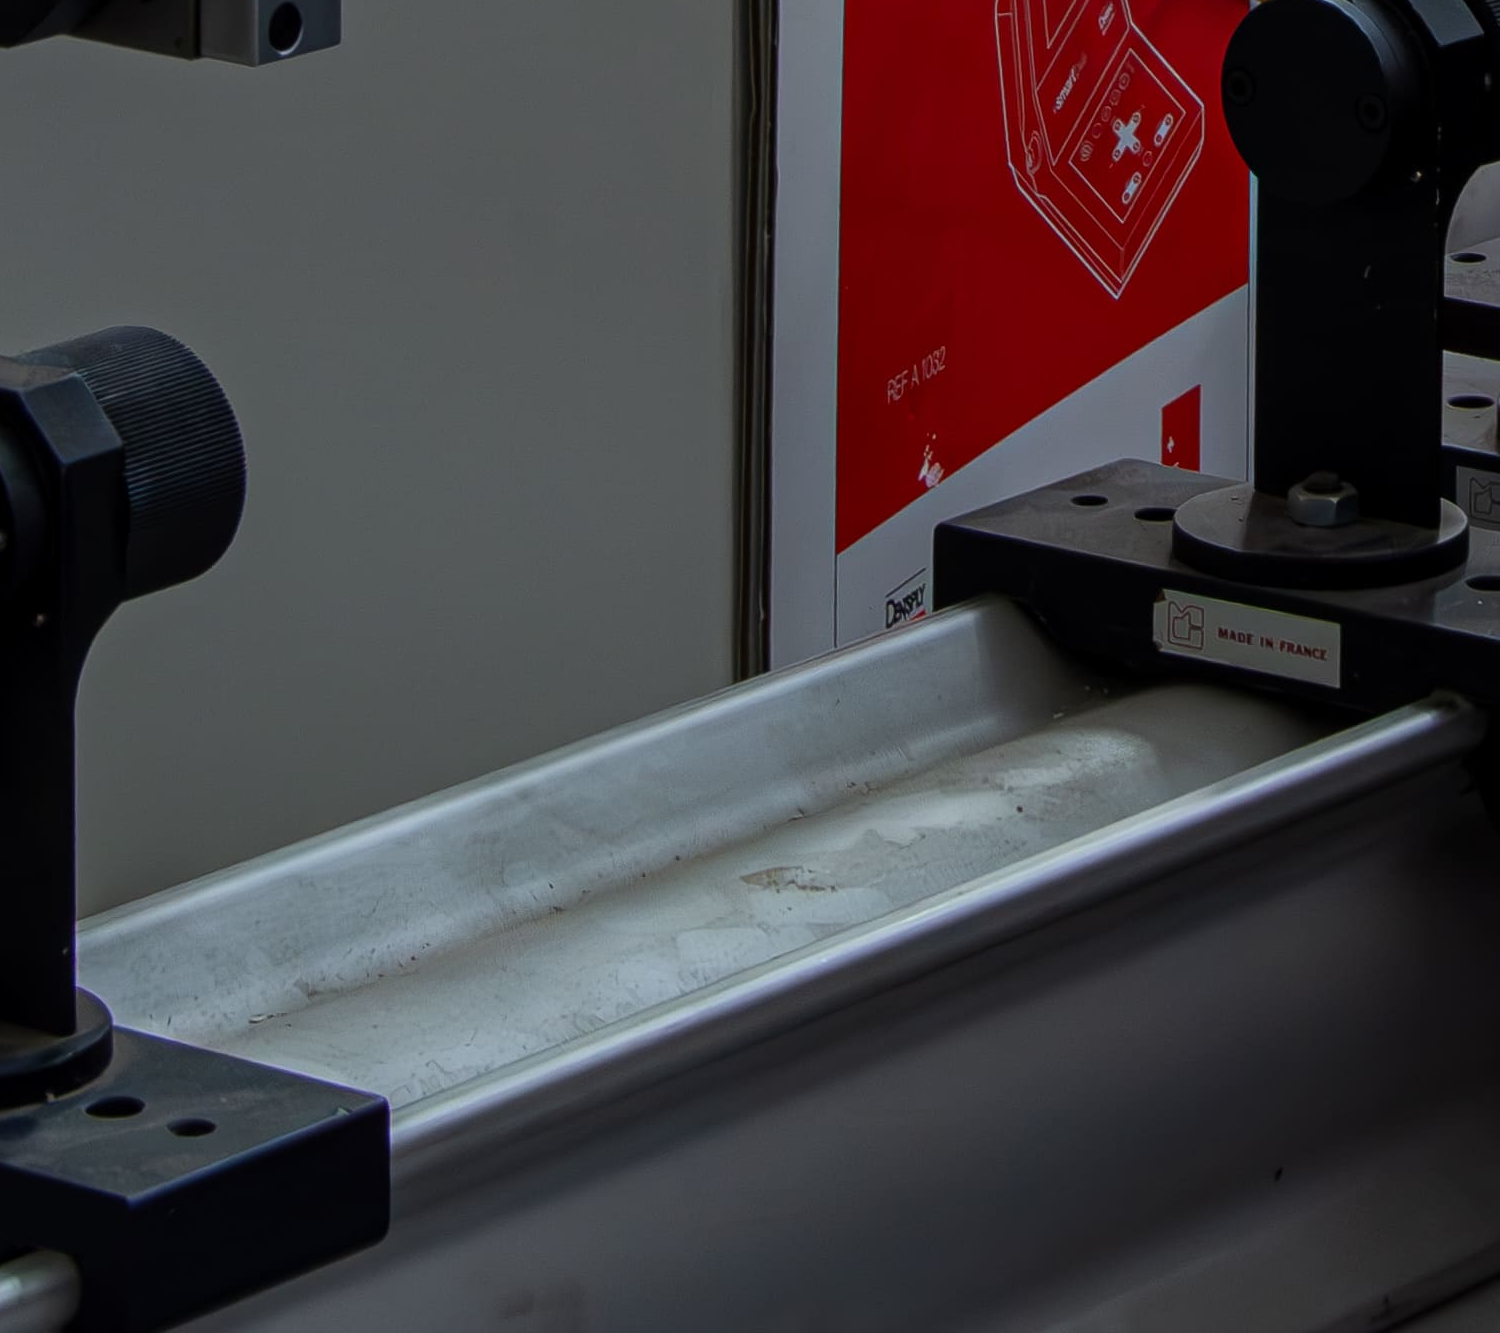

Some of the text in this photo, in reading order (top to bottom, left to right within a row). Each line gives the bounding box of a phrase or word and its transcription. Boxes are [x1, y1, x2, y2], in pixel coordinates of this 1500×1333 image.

[886, 369, 909, 405] REF
[1217, 627, 1328, 661] MADE IN FRANCE
